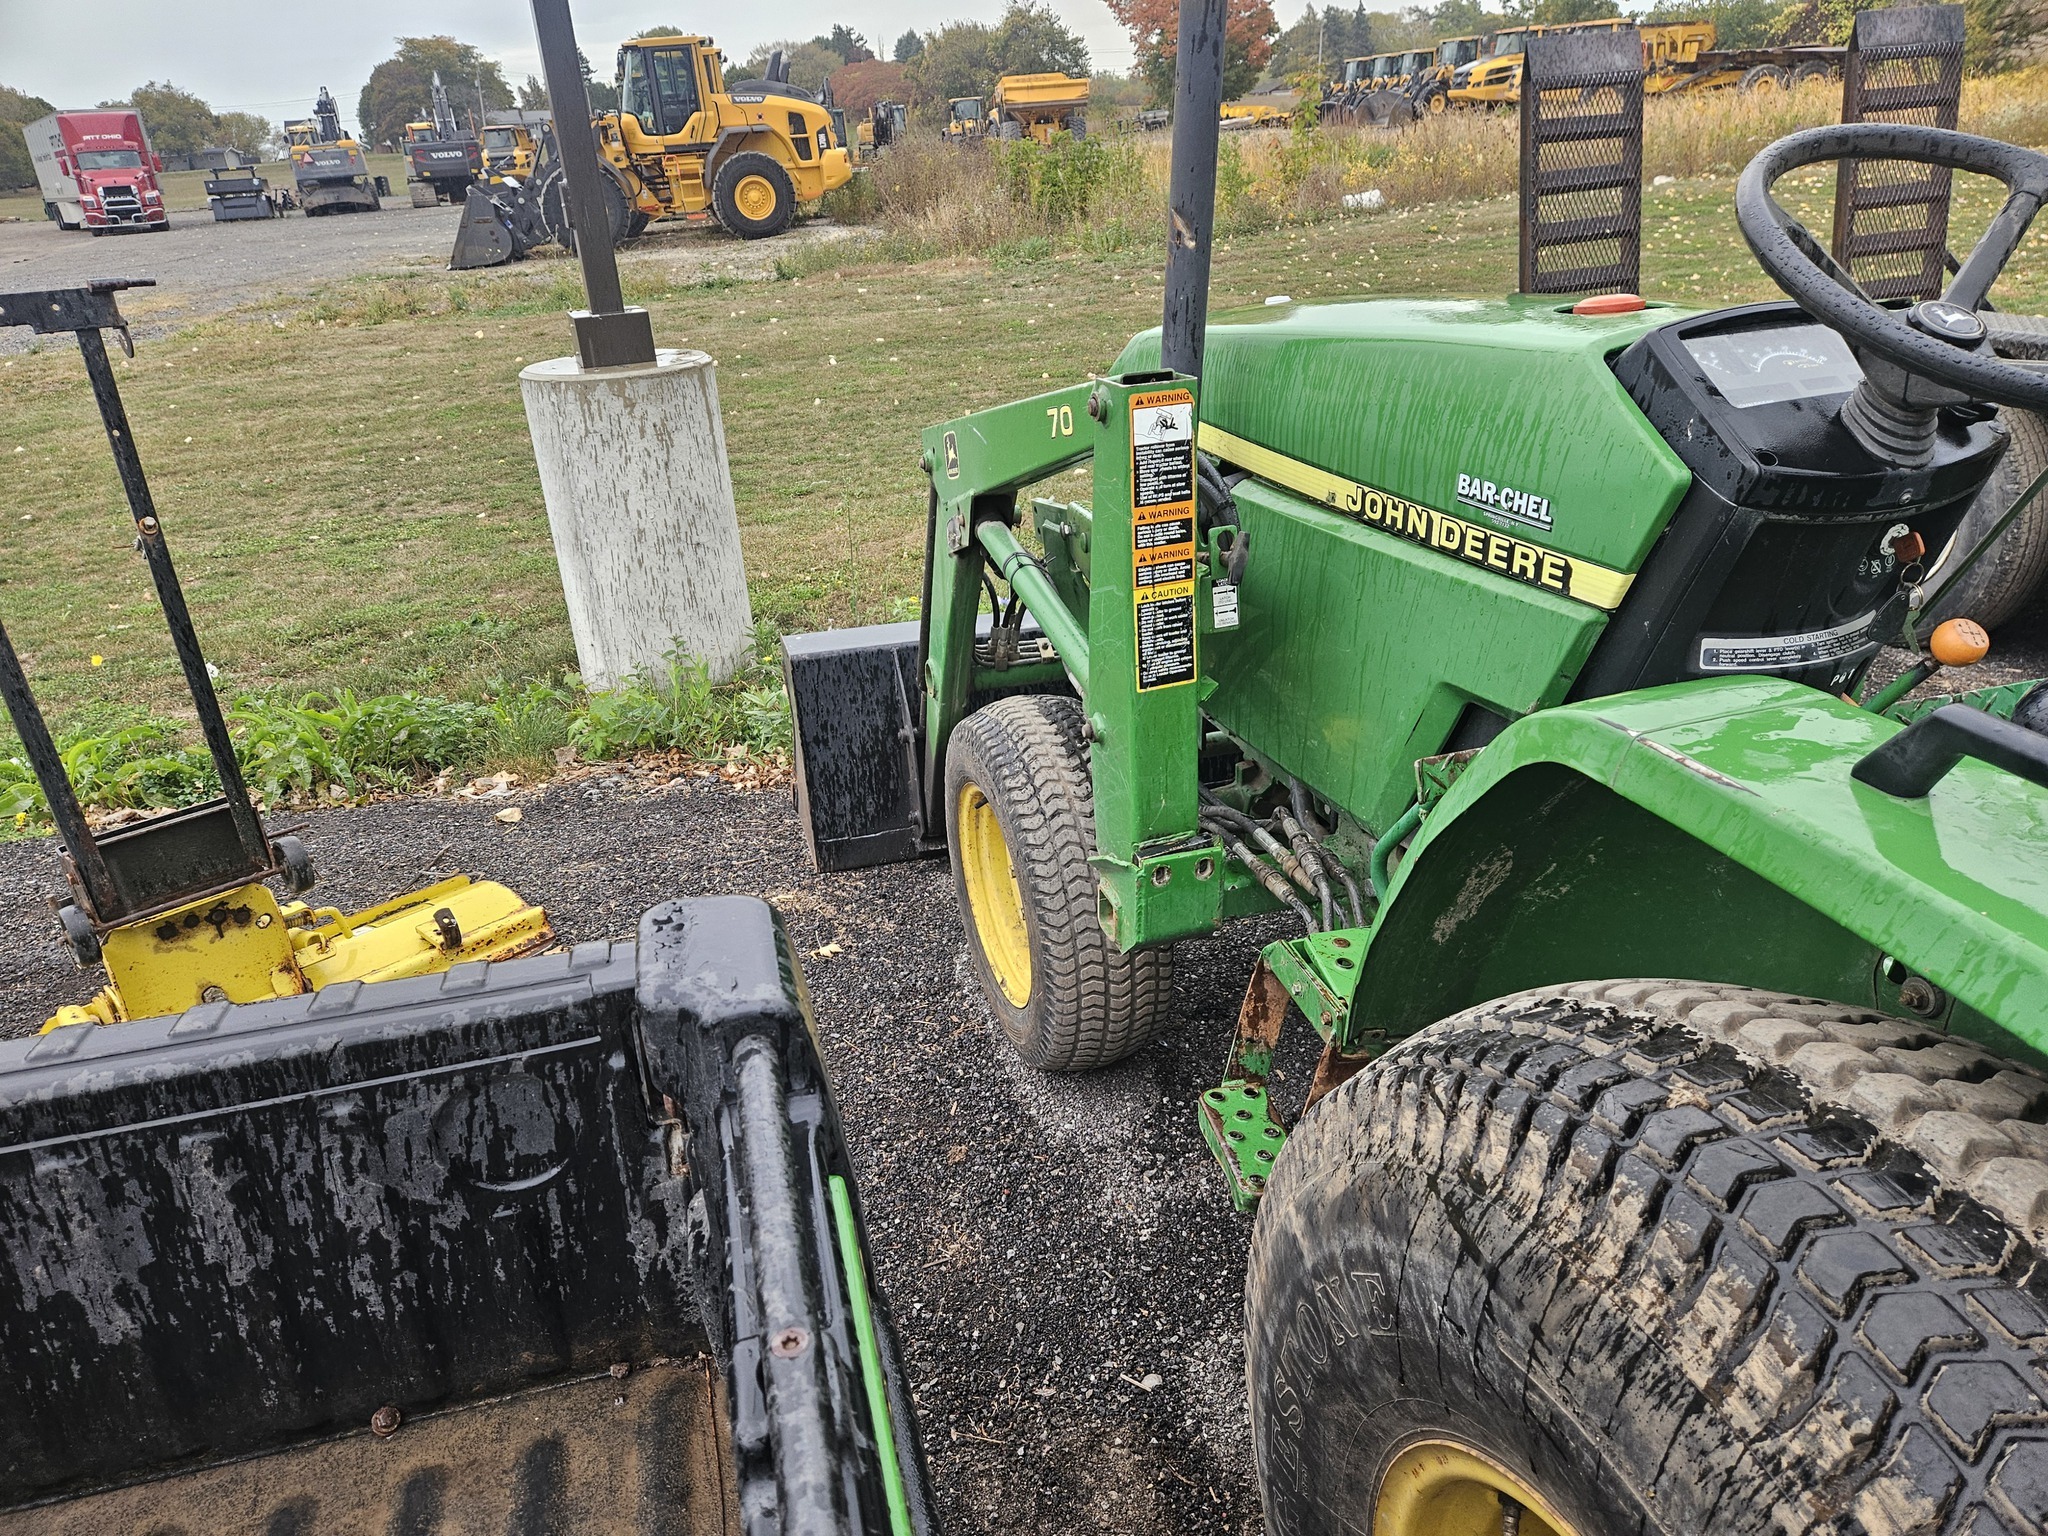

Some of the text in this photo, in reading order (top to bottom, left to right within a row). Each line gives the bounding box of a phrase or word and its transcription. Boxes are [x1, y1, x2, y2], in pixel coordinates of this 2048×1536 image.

[430, 150, 463, 159] VOLVO
[314, 159, 341, 167] VOLVO
[1146, 391, 1190, 405] WARNING
[1046, 403, 1074, 439] 70
[1457, 472, 1553, 523] BAR-CHEL
[1148, 506, 1190, 519] WARNING
[1345, 485, 1572, 593] JOHN DEERE
[1149, 548, 1190, 561] WARNING
[1151, 586, 1189, 600] CAUTION
[1783, 636, 1804, 645] COLD
[1806, 629, 1839, 642] STARTING
